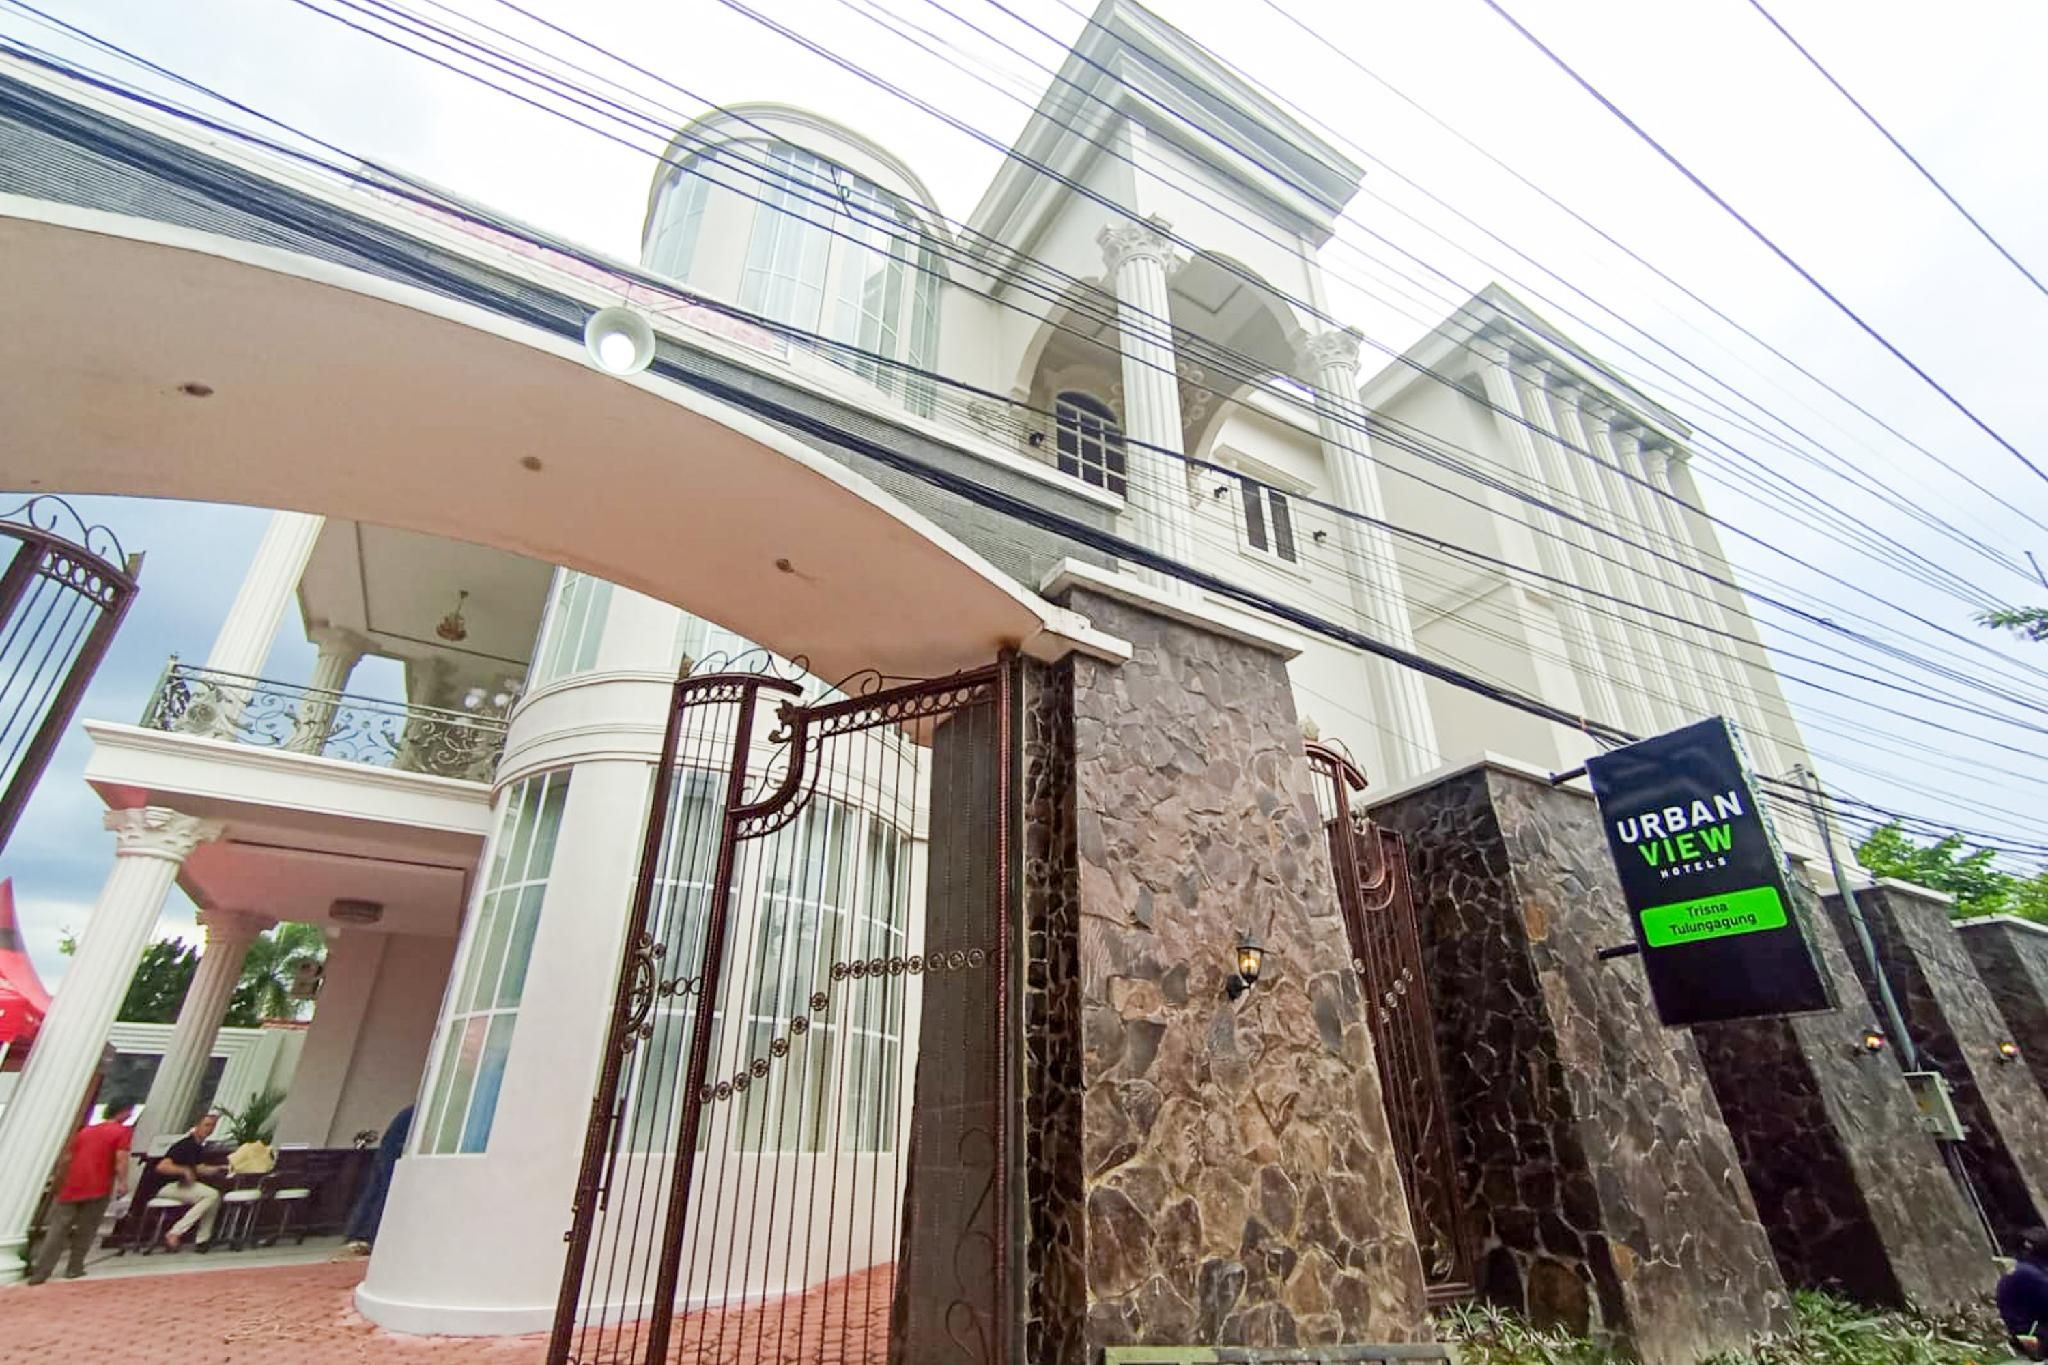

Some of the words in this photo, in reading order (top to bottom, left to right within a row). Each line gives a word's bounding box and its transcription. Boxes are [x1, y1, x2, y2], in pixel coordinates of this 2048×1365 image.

[1617, 791, 1744, 842] URBAN
[1639, 824, 1732, 866] VIEW
[1660, 857, 1727, 879] HOTELS
[1686, 902, 1728, 918] Trisna
[1670, 914, 1757, 936] Tulungagung
